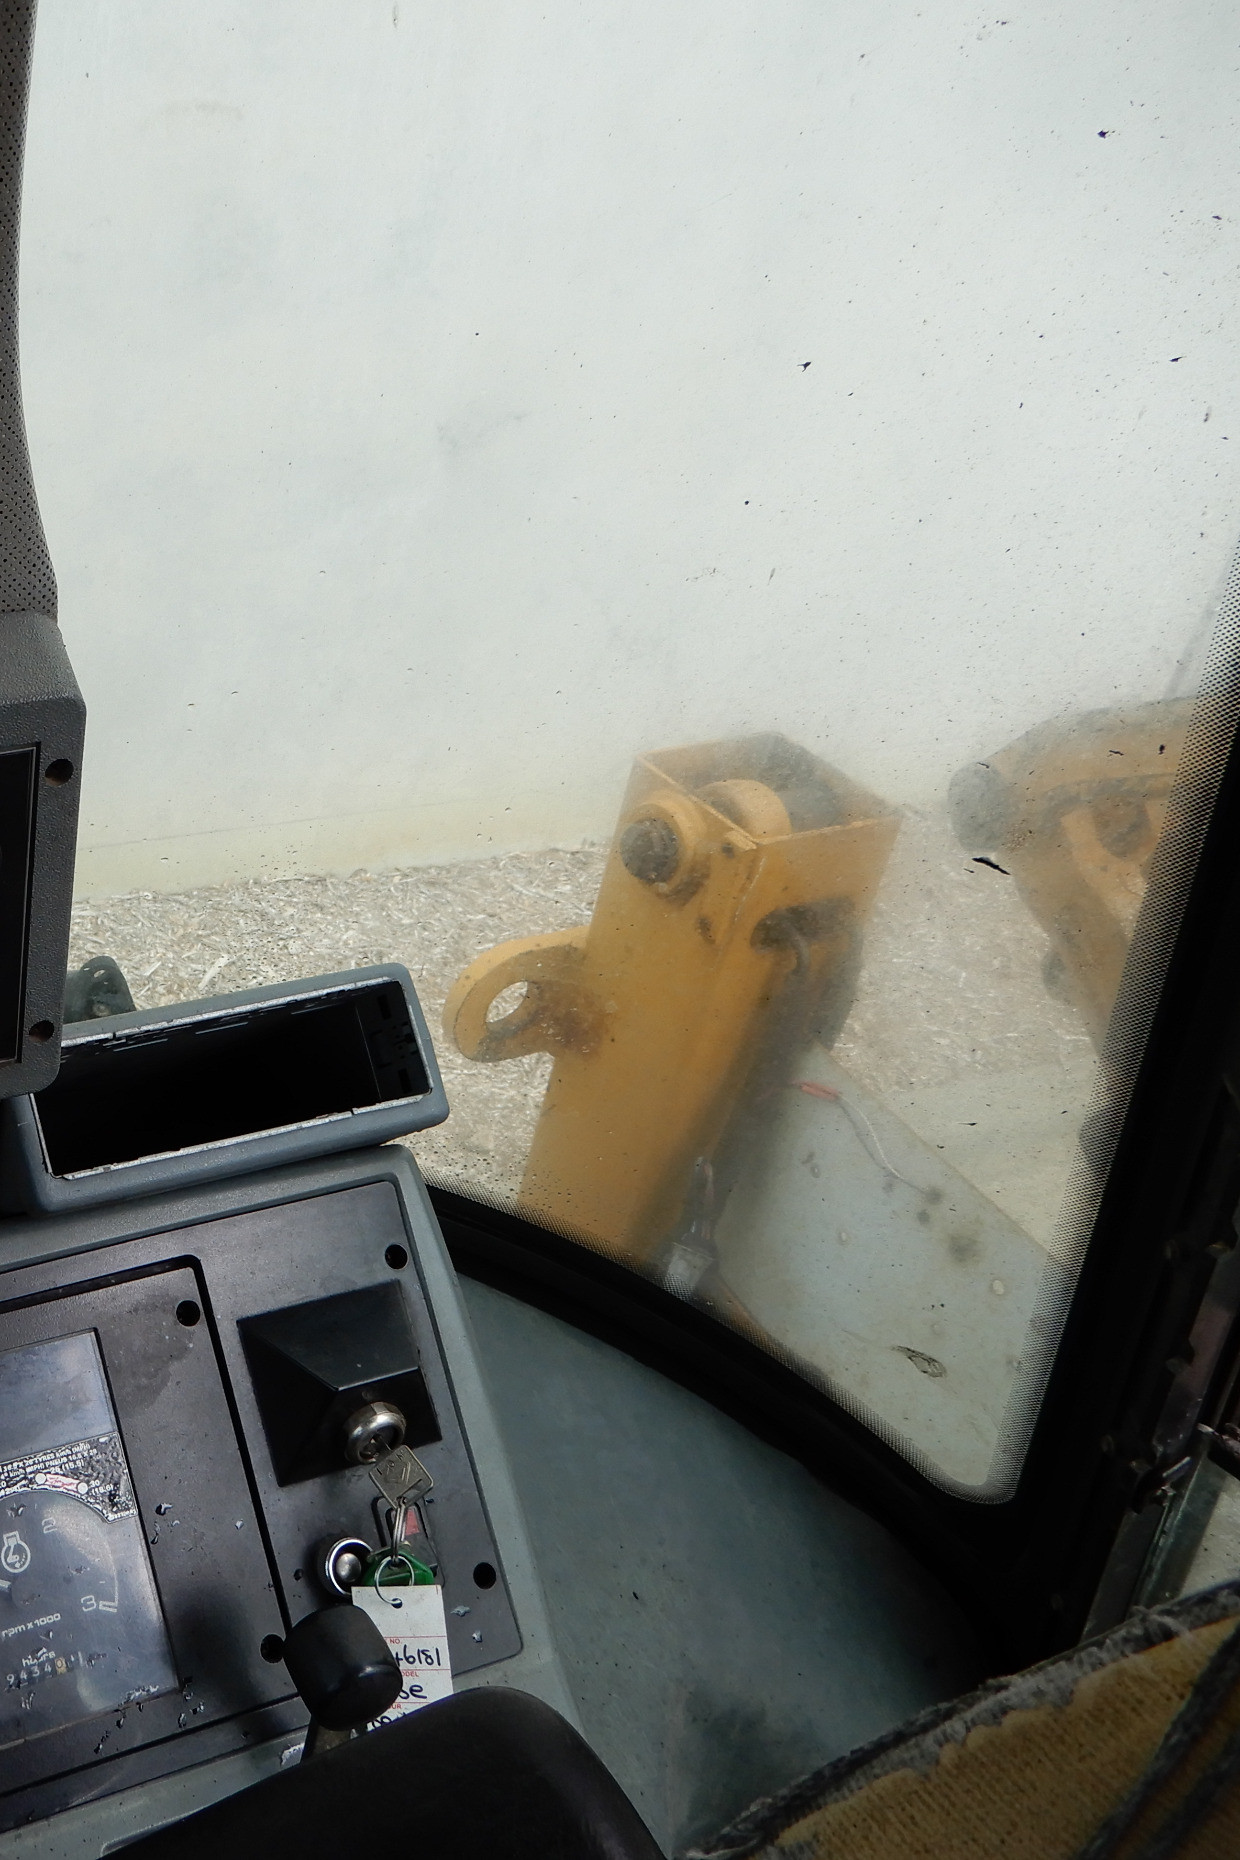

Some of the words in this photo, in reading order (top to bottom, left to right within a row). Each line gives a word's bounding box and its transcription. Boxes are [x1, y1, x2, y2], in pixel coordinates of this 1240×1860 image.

[80, 1595, 96, 1612] 3
[1, 1624, 26, 1640] rpm
[34, 1613, 61, 1627] 1000
